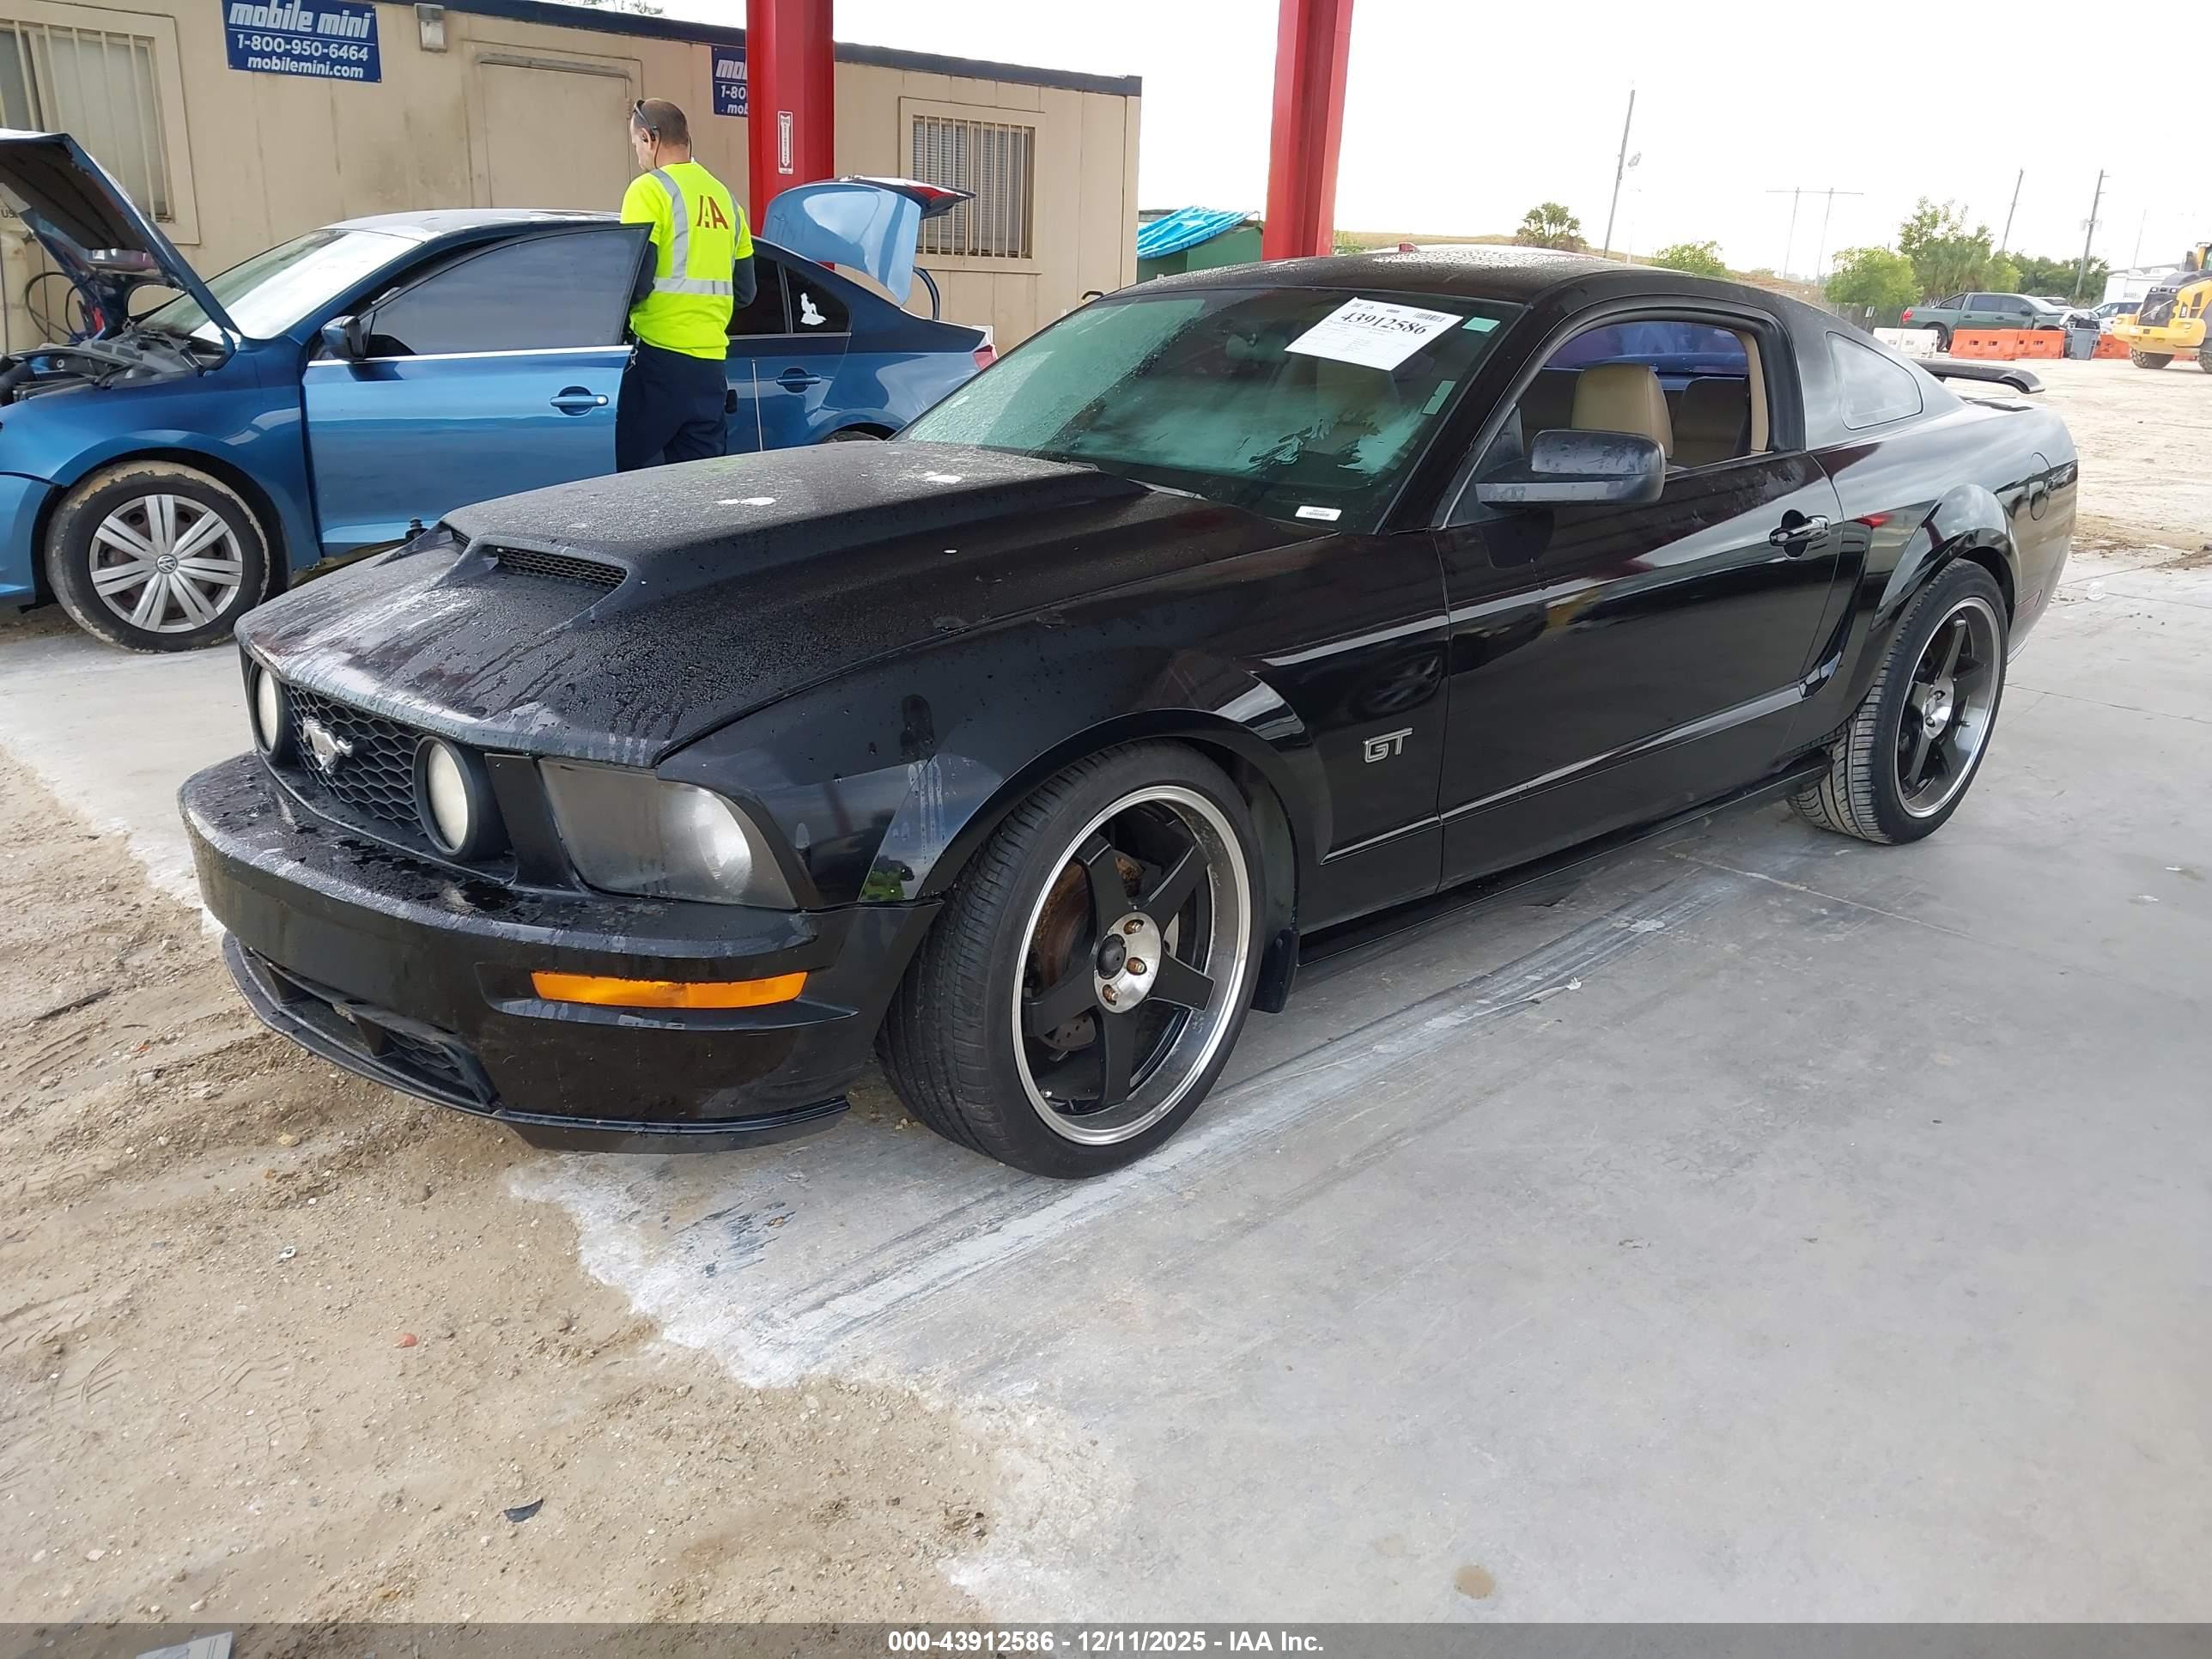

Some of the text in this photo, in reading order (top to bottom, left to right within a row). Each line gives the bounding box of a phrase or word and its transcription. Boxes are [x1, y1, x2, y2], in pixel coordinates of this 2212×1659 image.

[228, 0, 372, 39] mobile mini
[237, 34, 368, 61] 1-800-950-6464
[247, 56, 364, 78] mobilemini.com
[1340, 312, 1433, 335] 43912586
[1363, 727, 1413, 763] GT
